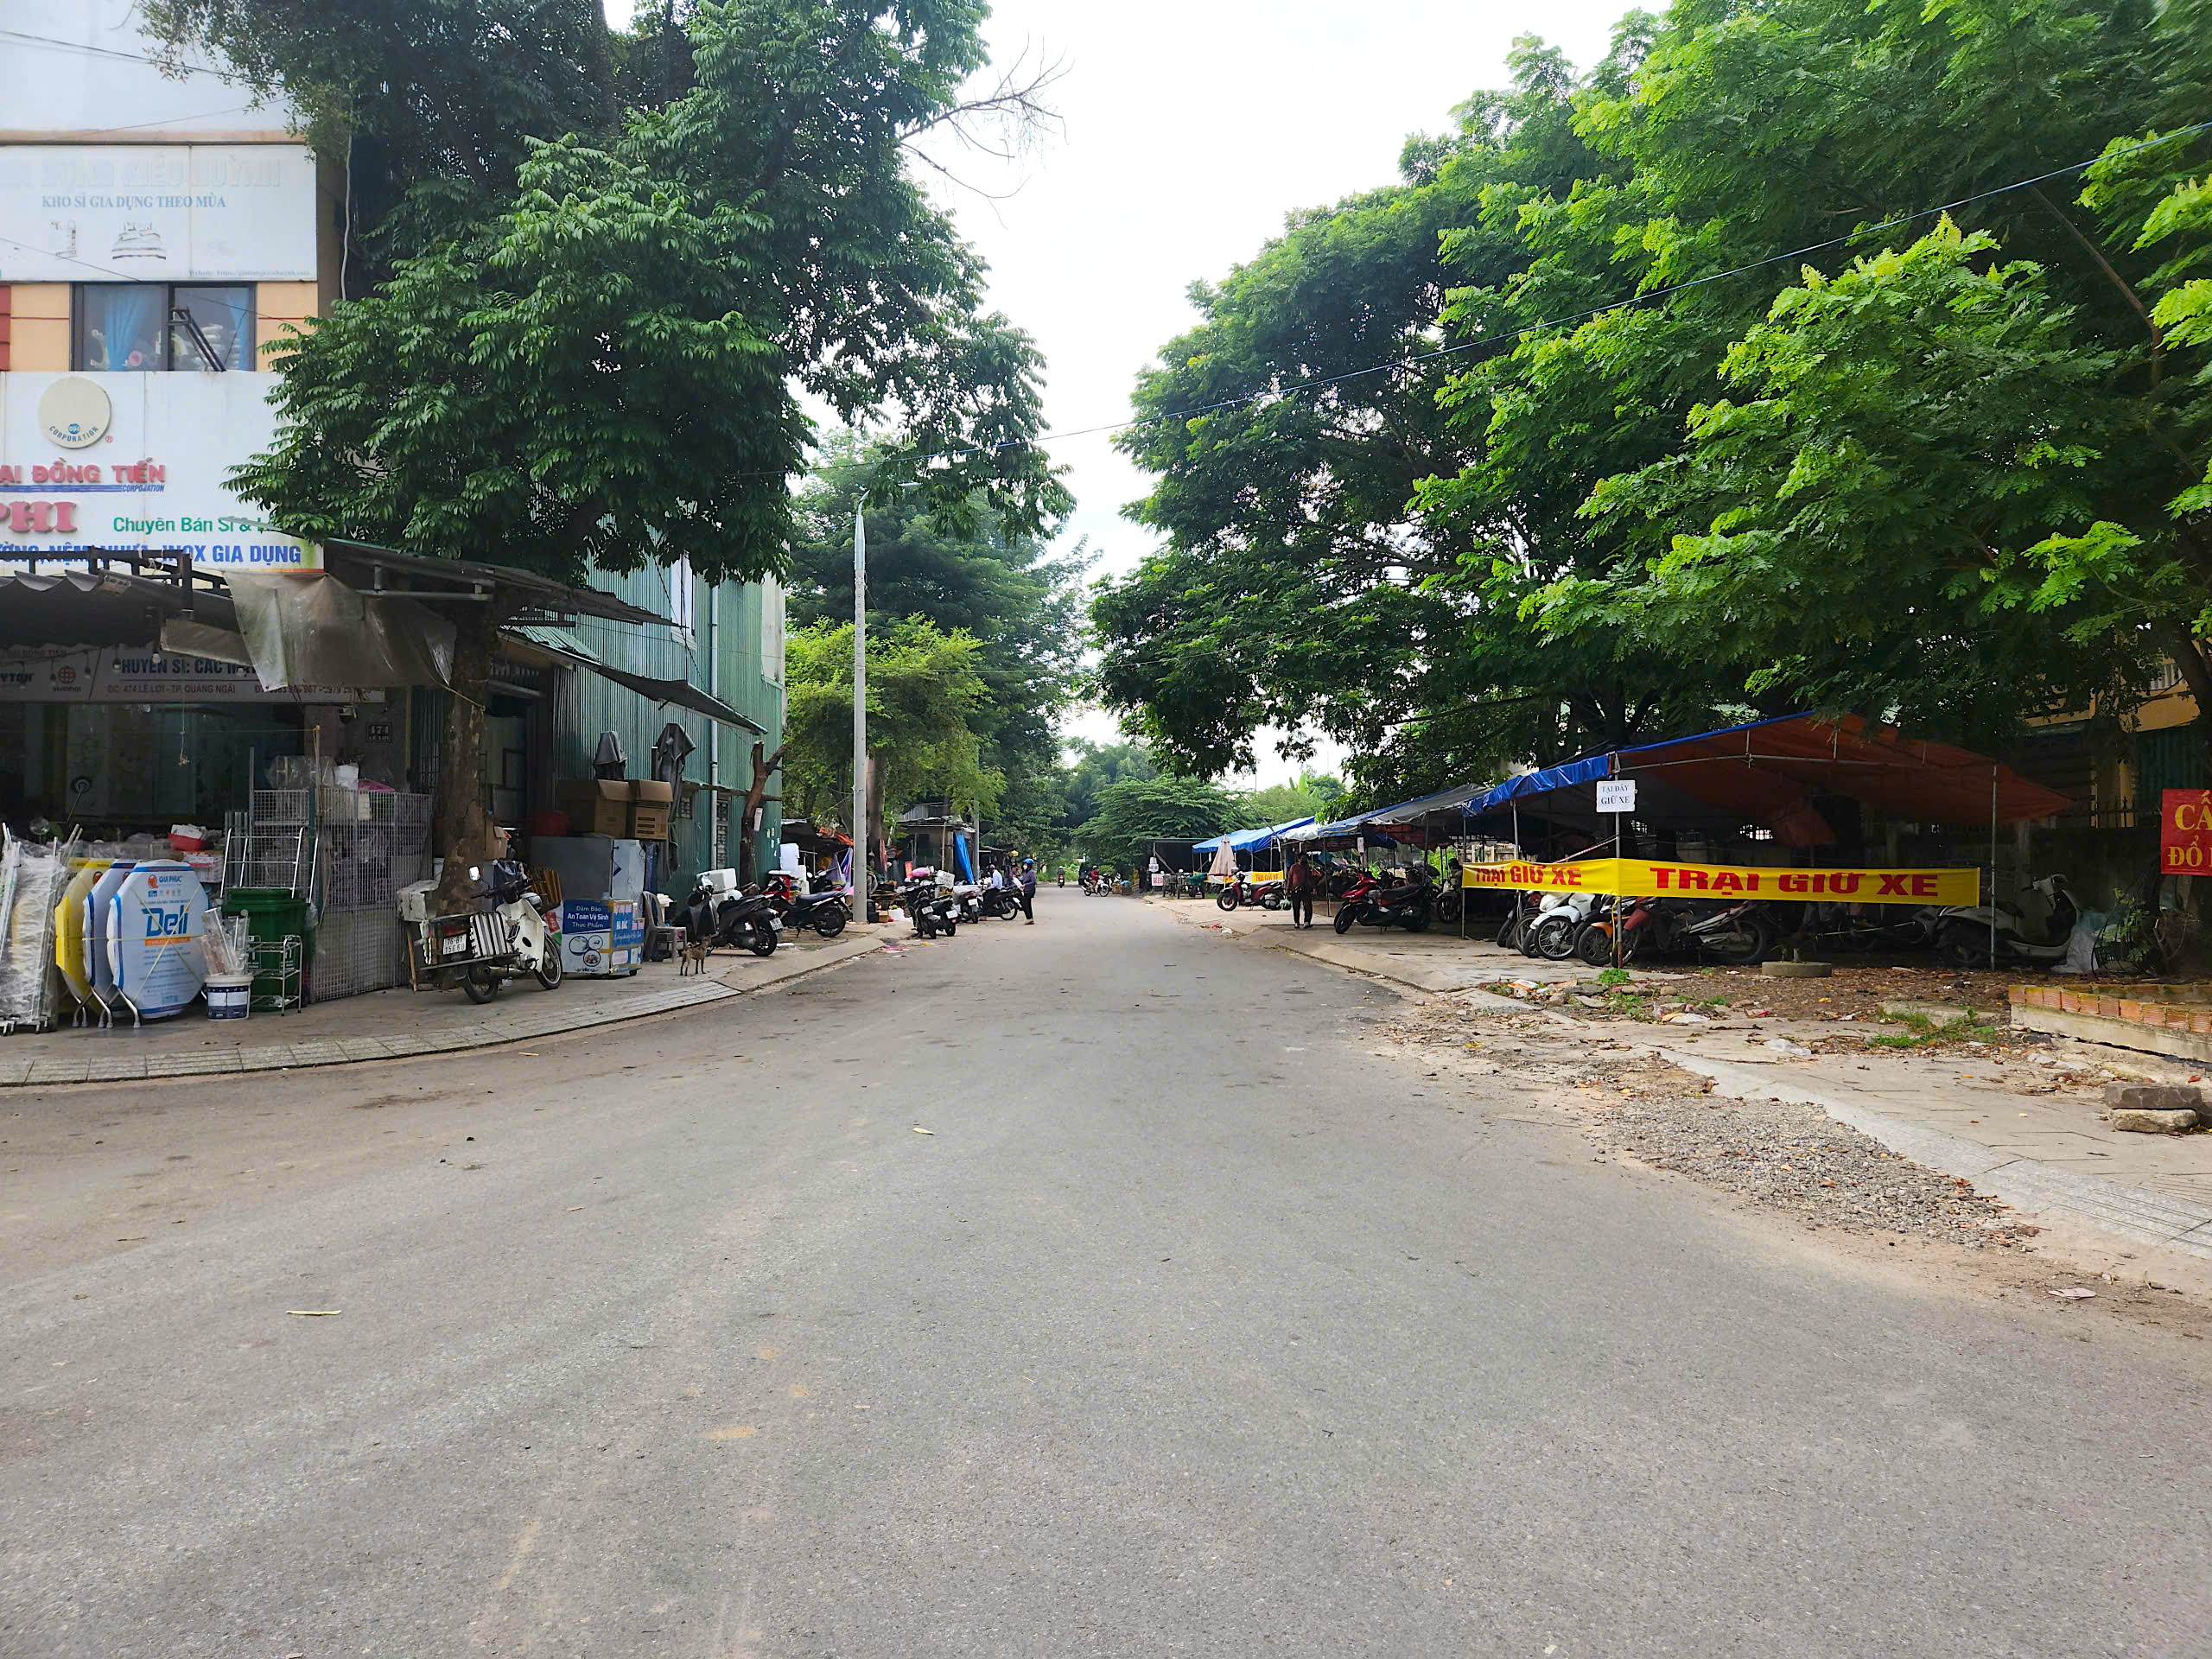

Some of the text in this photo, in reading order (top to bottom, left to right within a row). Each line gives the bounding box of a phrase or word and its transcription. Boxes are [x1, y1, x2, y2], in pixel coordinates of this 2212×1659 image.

[42, 195, 71, 208] KHO
[90, 195, 114, 208] GIA
[117, 195, 154, 211] DỤNG
[156, 195, 193, 208] THEO
[196, 192, 226, 208] MÙA
[49, 425, 99, 442] CORPORATION
[32, 457, 101, 484] ĐỒNG
[111, 457, 166, 484] TIẾN
[113, 517, 175, 536] Chuyên
[181, 517, 213, 532] Bán
[212, 544, 244, 563] GIA
[250, 544, 302, 566] DỤNG
[2167, 835, 2203, 868] ĐỔ
[1475, 867, 1506, 887] TRẠI
[1551, 867, 1583, 887] XE
[1649, 867, 1760, 896] TRẠI
[1877, 873, 1939, 897] XE
[141, 905, 189, 938] Deli
